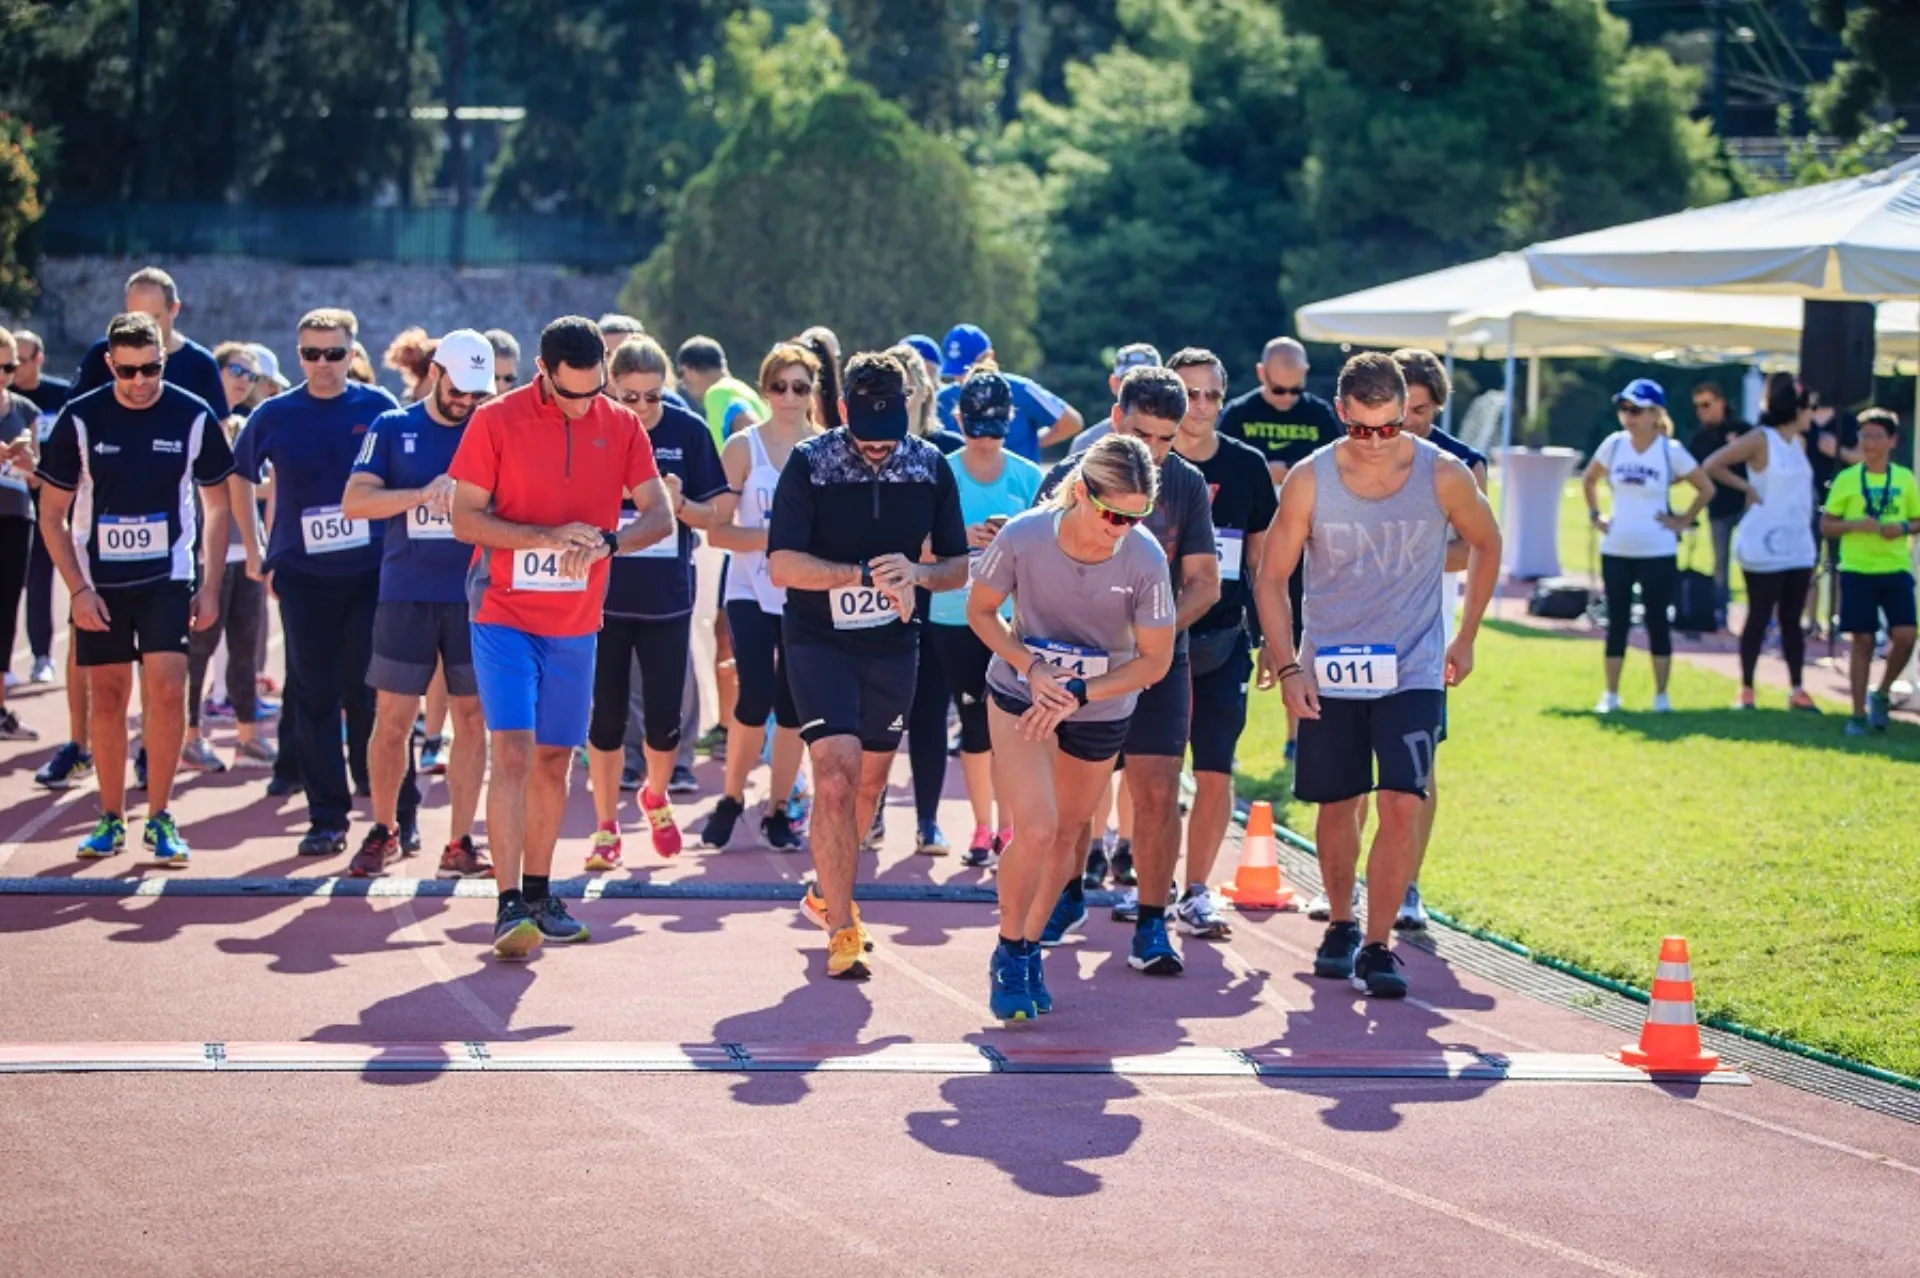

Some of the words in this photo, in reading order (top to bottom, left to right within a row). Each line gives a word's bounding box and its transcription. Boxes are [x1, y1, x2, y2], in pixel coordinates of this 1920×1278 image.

[1242, 421, 1320, 442] WITNESS
[107, 528, 151, 549] 009
[310, 517, 354, 541] 050
[523, 552, 557, 577] 04
[840, 590, 891, 616] 026
[1326, 660, 1373, 684] 011
